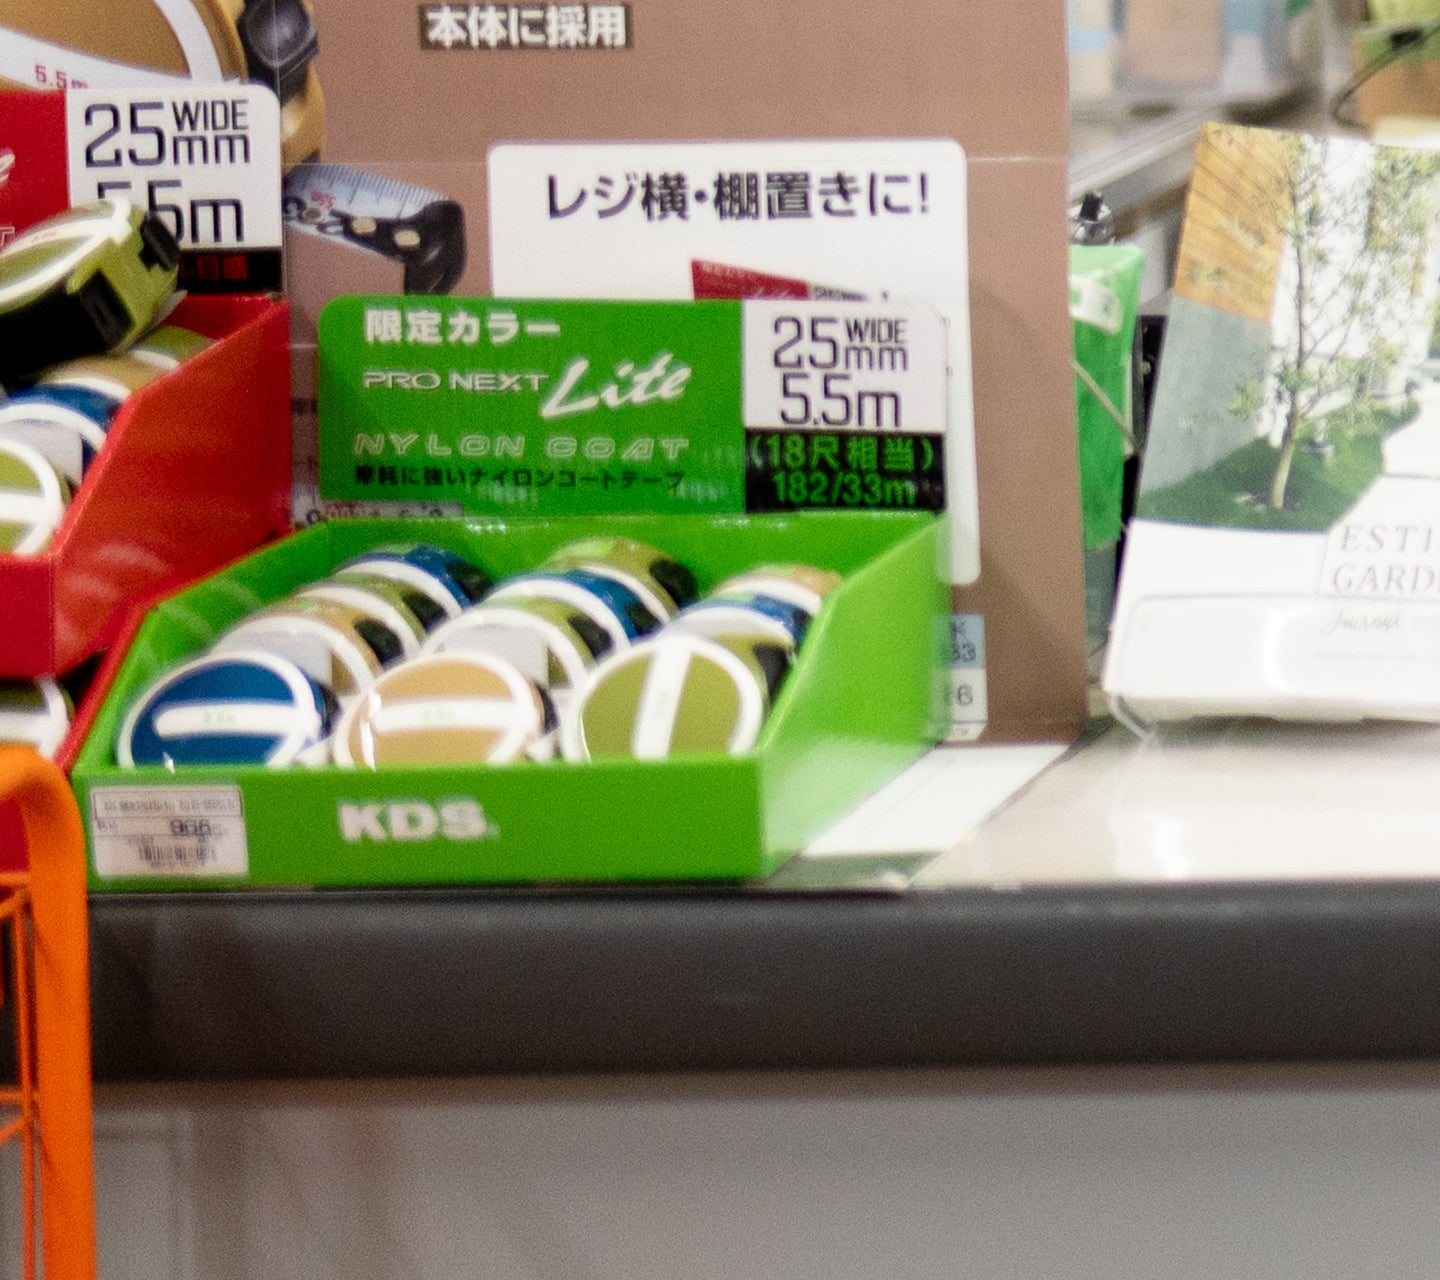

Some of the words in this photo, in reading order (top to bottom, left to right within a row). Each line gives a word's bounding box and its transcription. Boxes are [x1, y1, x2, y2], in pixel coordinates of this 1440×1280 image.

[427, 6, 627, 49] 本体に採用
[172, 99, 249, 132] WIDE
[85, 101, 165, 168] 25
[172, 134, 250, 166] mm
[365, 308, 561, 346] 限定カラー
[773, 316, 839, 371] 25
[846, 316, 908, 344] WIDE
[848, 346, 911, 371] mm
[362, 371, 441, 391] PRO
[450, 371, 550, 392] NEXT
[541, 351, 691, 419] Lite
[780, 373, 903, 428] 5.5m
[353, 432, 525, 459] NYLON
[546, 437, 690, 461] COAT
[354, 463, 686, 493] 摩耗に強いナイロンコートテープ
[772, 473, 916, 507] 182/33m
[341, 801, 489, 843] KDS
